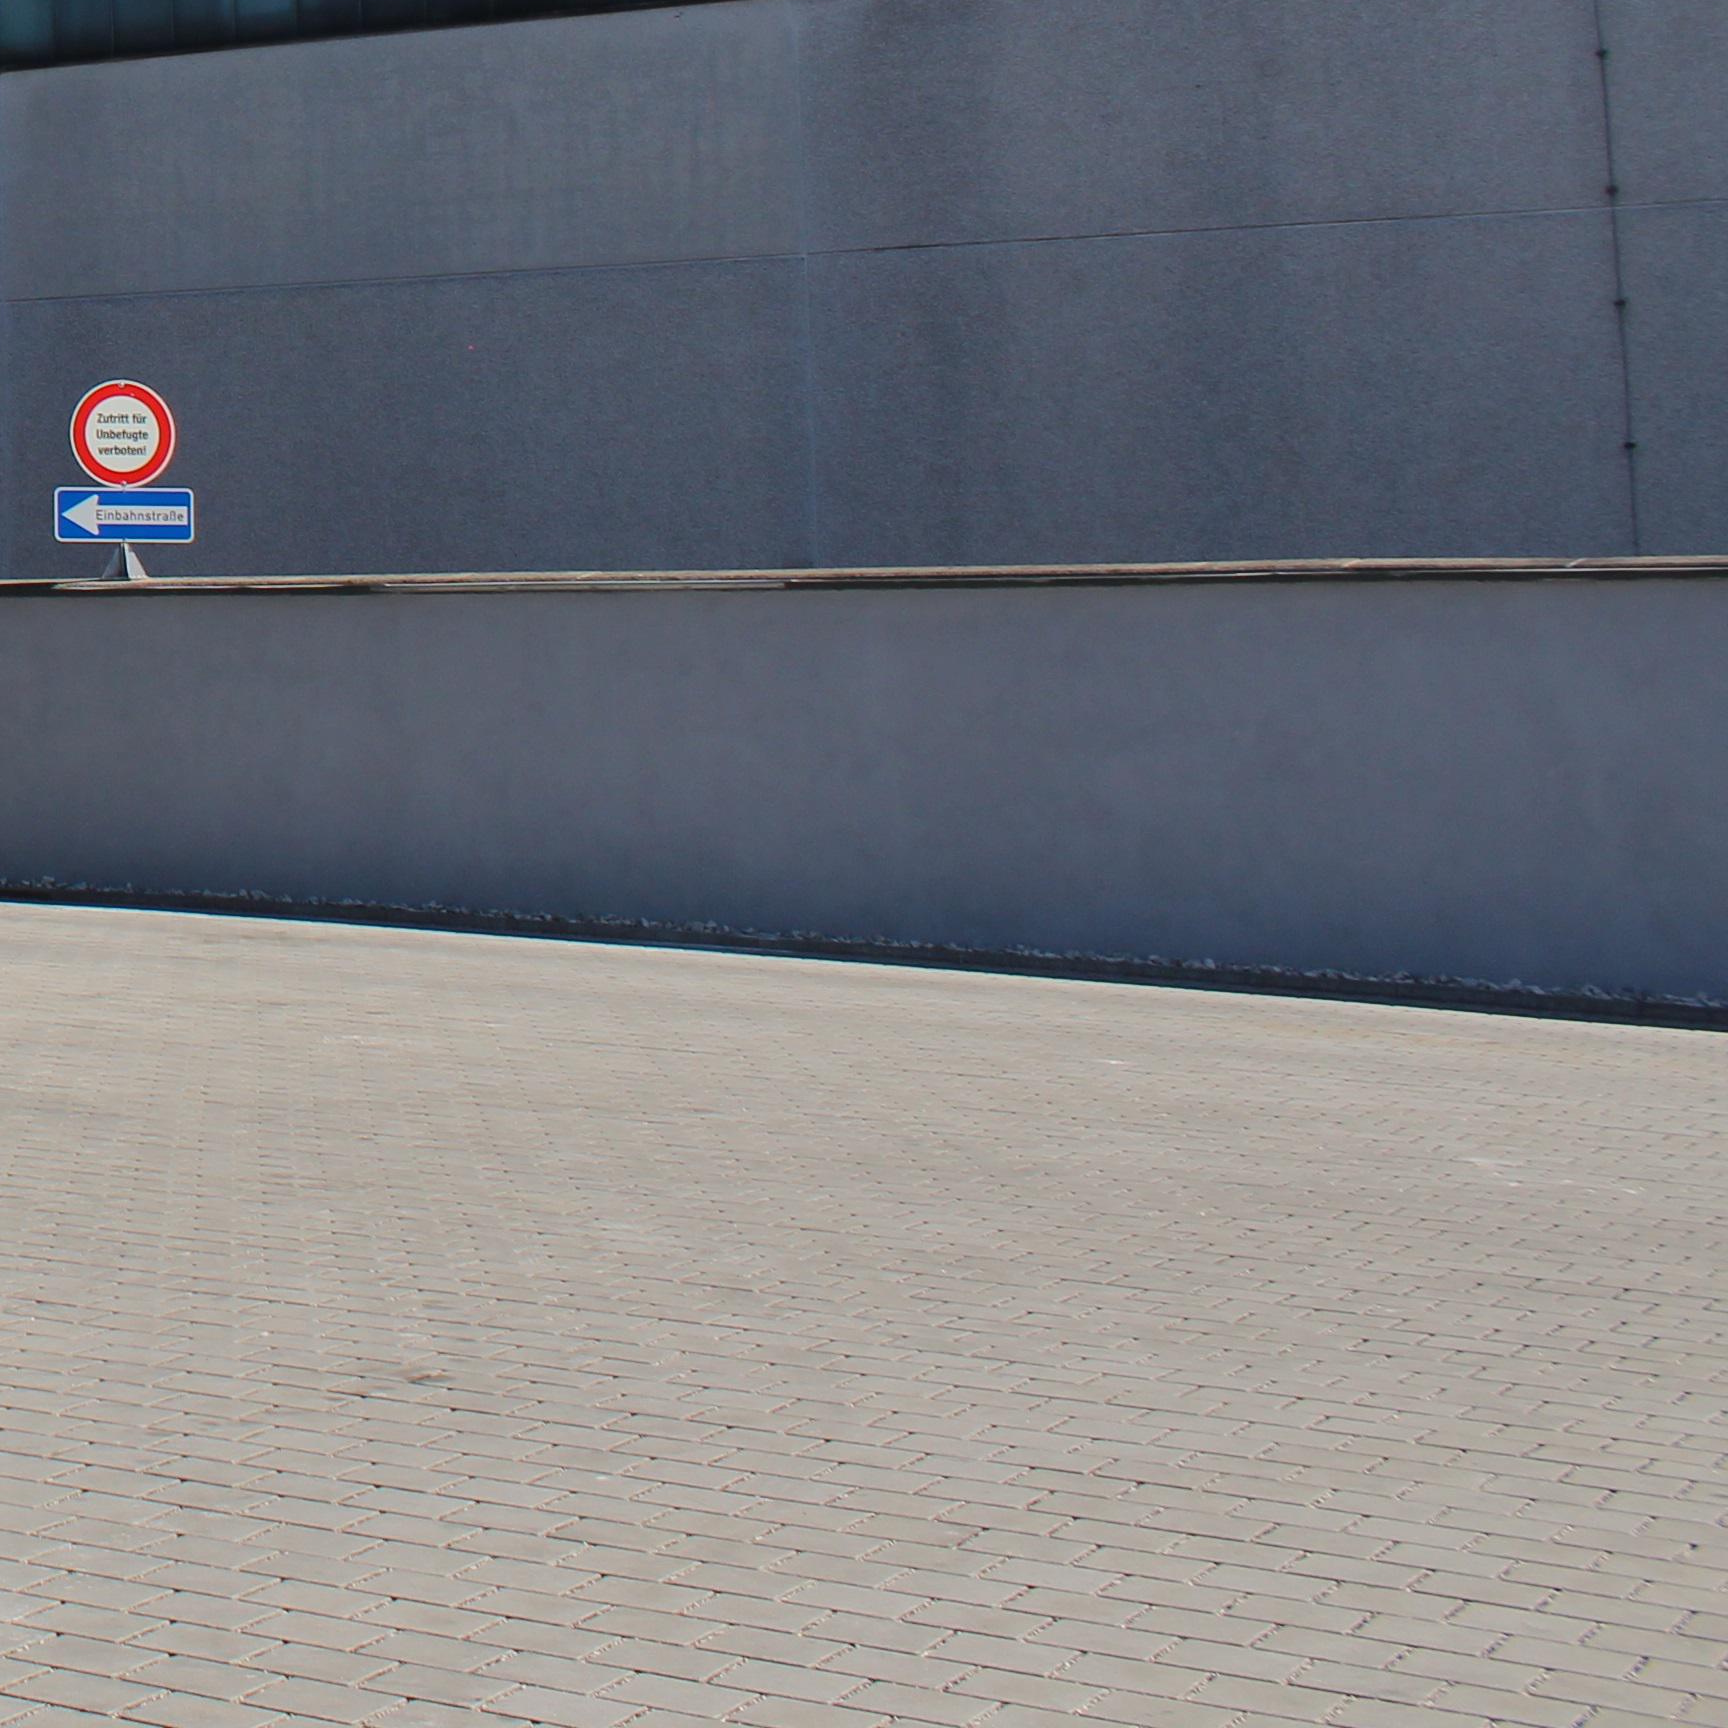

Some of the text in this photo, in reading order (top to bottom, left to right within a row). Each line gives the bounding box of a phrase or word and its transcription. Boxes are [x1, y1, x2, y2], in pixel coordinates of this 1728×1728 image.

[96, 413, 147, 424] Zutritt für
[96, 428, 149, 442] Unbefugte
[97, 445, 147, 456] verboten!
[95, 509, 184, 521] Einbahnstraße
